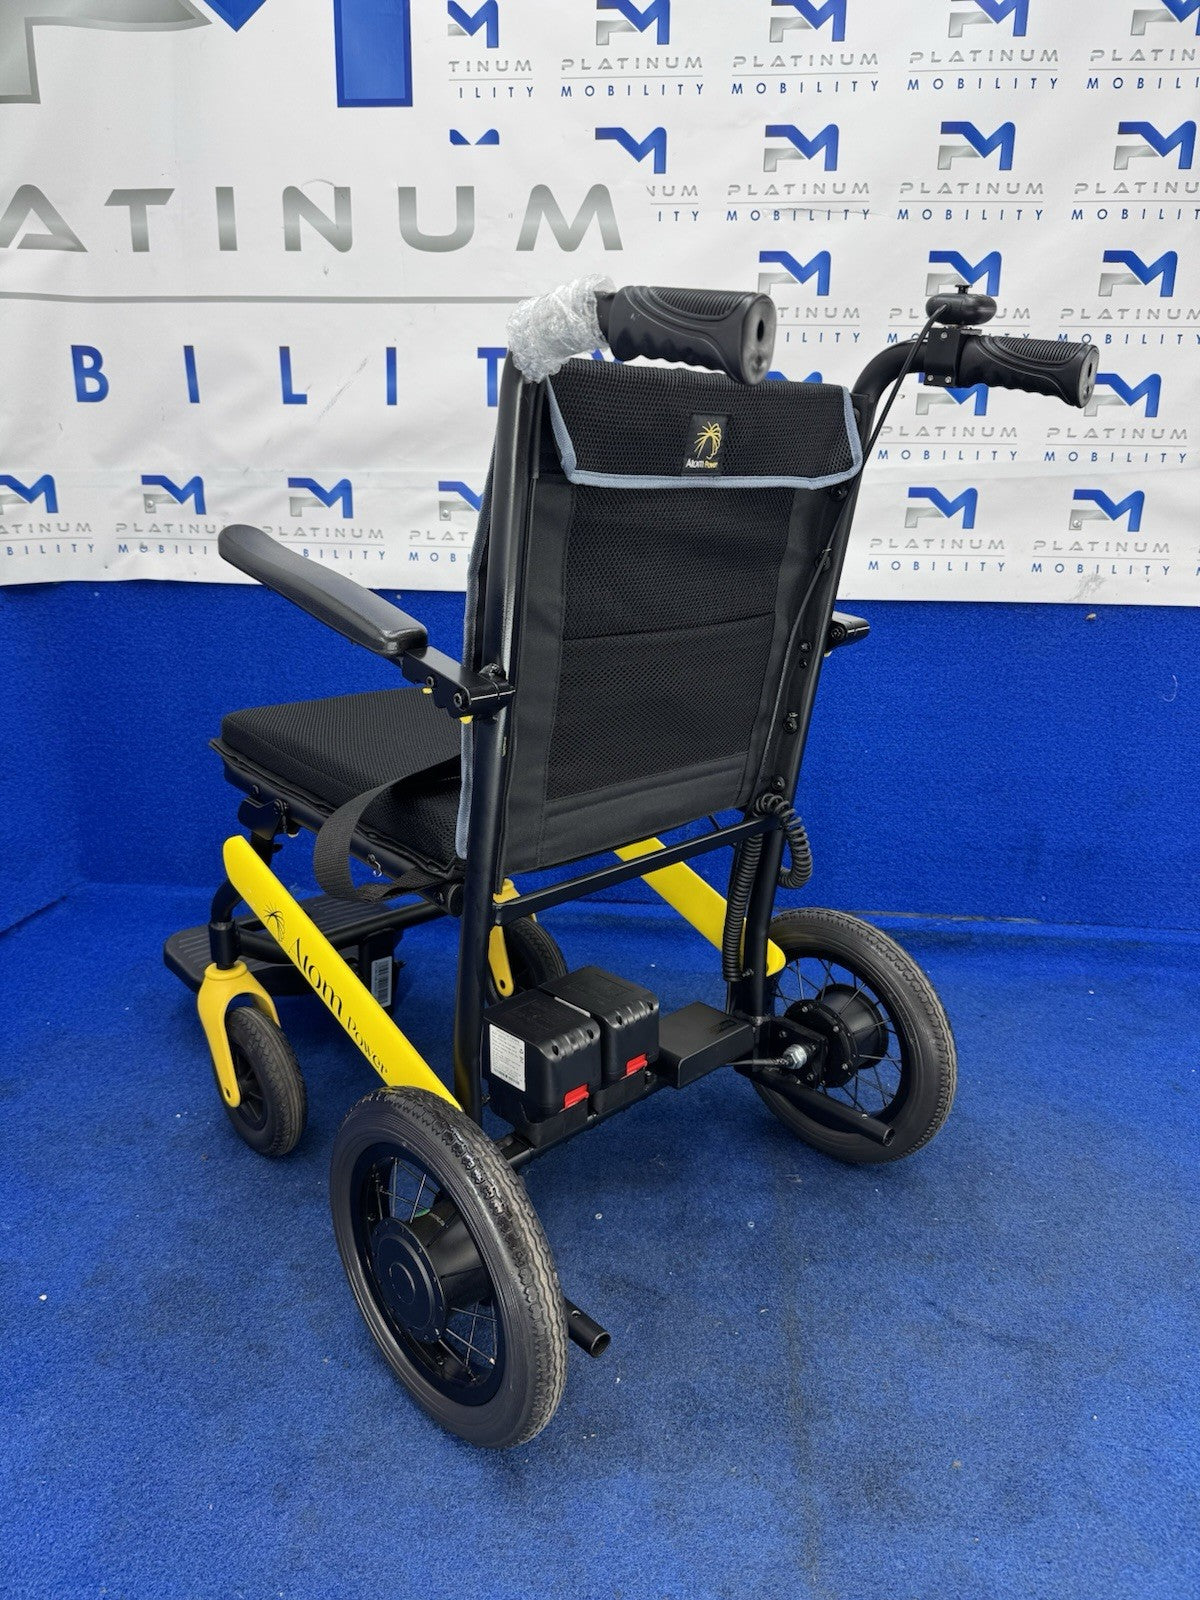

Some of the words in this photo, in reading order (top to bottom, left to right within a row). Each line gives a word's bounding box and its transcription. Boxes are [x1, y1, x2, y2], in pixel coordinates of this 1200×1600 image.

[733, 53, 878, 67] PLATINUM
[910, 50, 1058, 63] PLATINUM
[1090, 49, 1195, 61] PLATIN
[562, 57, 702, 70] PLATINUM
[732, 80, 878, 94] MOBILITY
[907, 78, 1058, 90] MOBILITY
[561, 84, 703, 97] MOBILITY
[728, 183, 869, 195] PLATINUM
[900, 183, 1043, 194] PLATINUM
[1075, 182, 1199, 194] PLATINU
[726, 209, 870, 223] MOBILITY
[897, 209, 1043, 220] MOBILITY
[71, 345, 623, 407] BILIT
[880, 425, 1018, 438] PLATINUM
[1047, 428, 1187, 439] PLATINUM
[878, 450, 1017, 460] MOBILITY
[1044, 451, 1186, 463] MOBILITY
[116, 522, 226, 534] PLATINU
[870, 539, 1004, 549] PLATINUM
[1033, 540, 1170, 553] PLATINUM
[868, 561, 1005, 571] MOBILITY
[1031, 563, 1170, 576] MOBILITY
[288, 937, 343, 1018] Atom
[346, 1016, 388, 1074] Power
